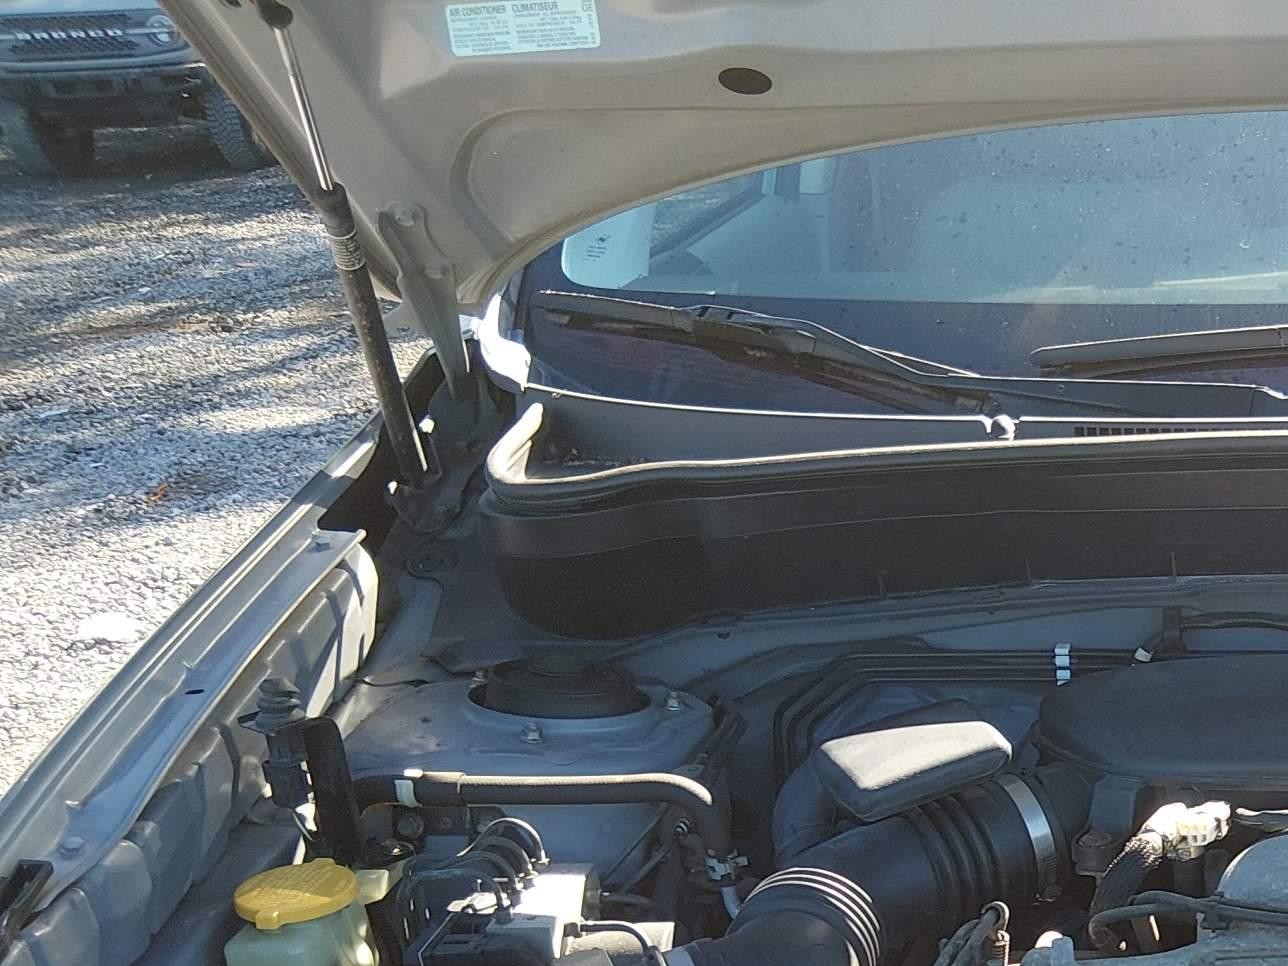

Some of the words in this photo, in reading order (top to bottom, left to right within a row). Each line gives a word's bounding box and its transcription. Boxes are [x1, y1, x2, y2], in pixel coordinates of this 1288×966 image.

[461, 5, 507, 17] CONDITIONER
[512, 1, 559, 13] CLIMATISEUR
[15, 28, 124, 41] BRONCO
